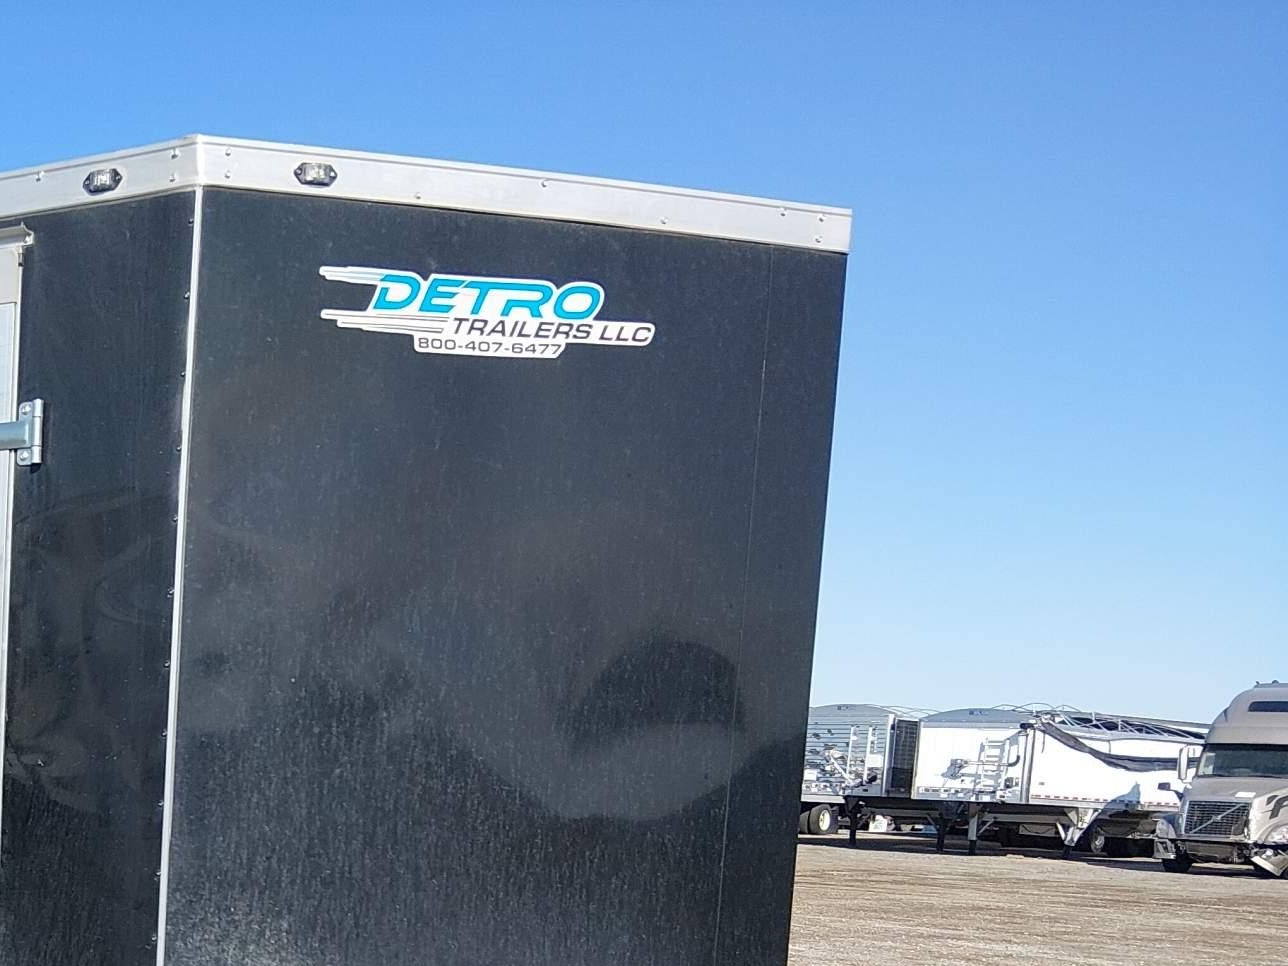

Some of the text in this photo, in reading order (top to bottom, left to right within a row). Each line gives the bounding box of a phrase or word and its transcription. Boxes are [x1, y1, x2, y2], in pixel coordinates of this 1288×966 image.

[372, 273, 602, 321] DETRO
[453, 317, 652, 343] TRAILERS LLC
[418, 337, 562, 355] 800-407-6477
